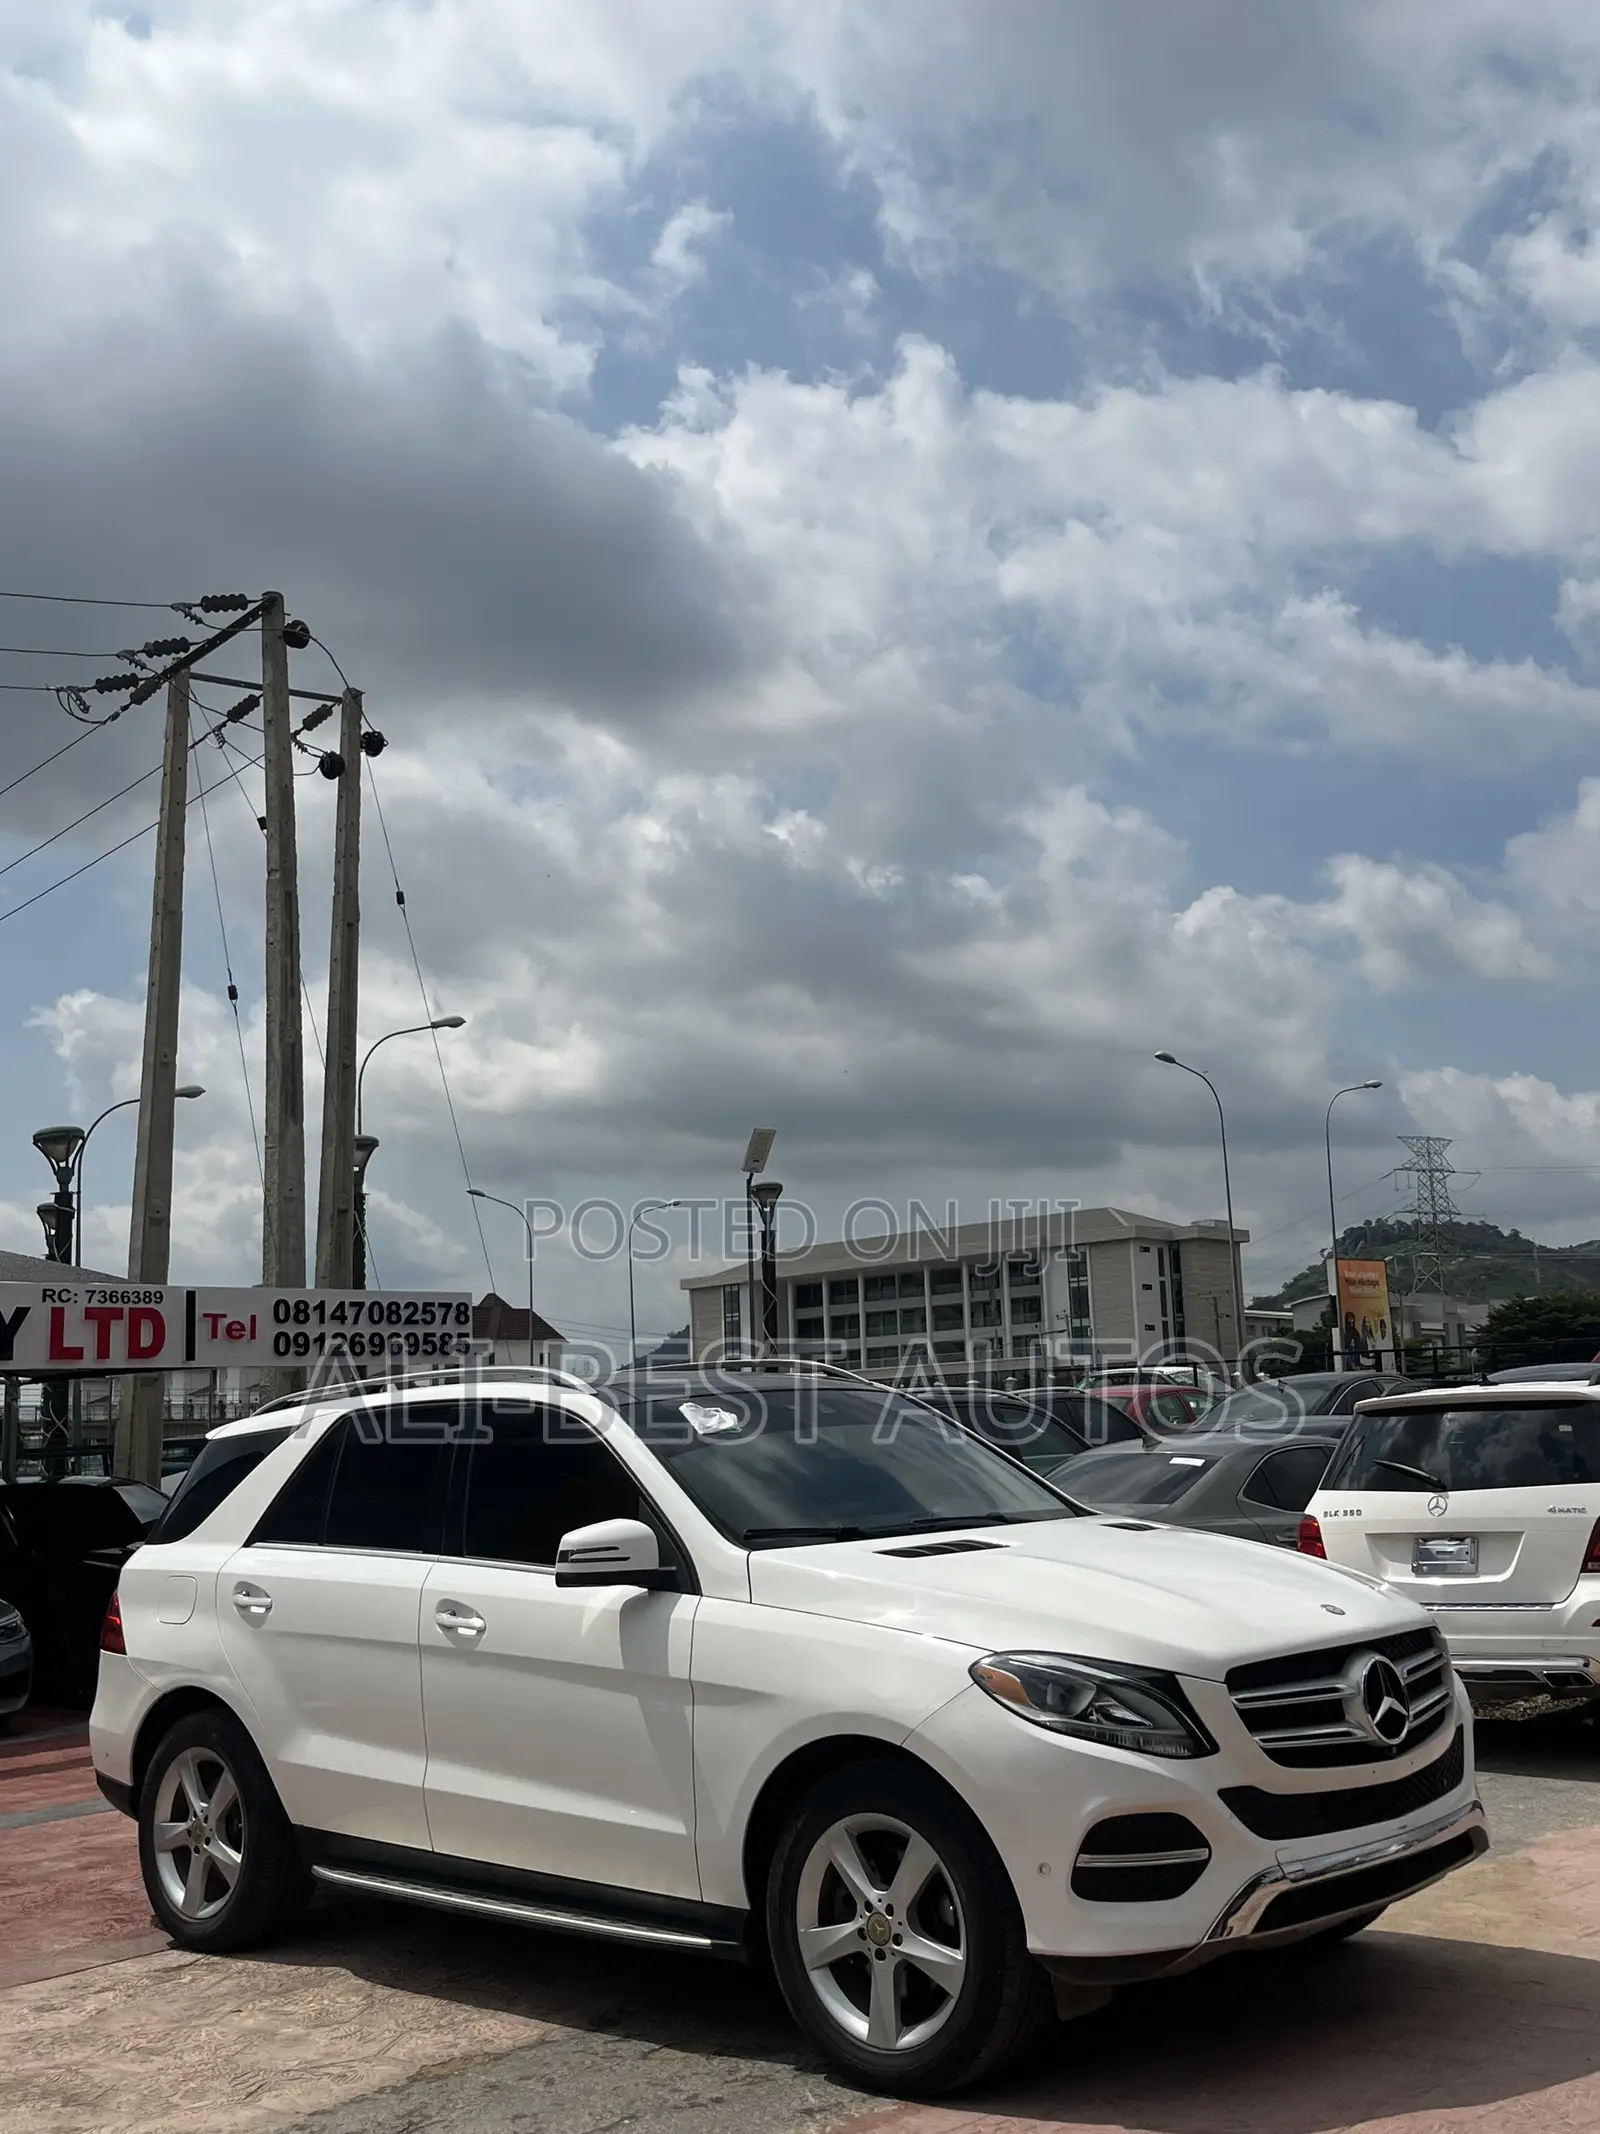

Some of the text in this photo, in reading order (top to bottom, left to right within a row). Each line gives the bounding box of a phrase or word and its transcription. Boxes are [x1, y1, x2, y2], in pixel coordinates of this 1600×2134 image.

[42, 1288, 164, 1304] RC: 7366389
[273, 1299, 470, 1325] 08147082578
[49, 1306, 165, 1360] LTD
[203, 1313, 257, 1340] Tel
[273, 1331, 470, 1357] 09126969585
